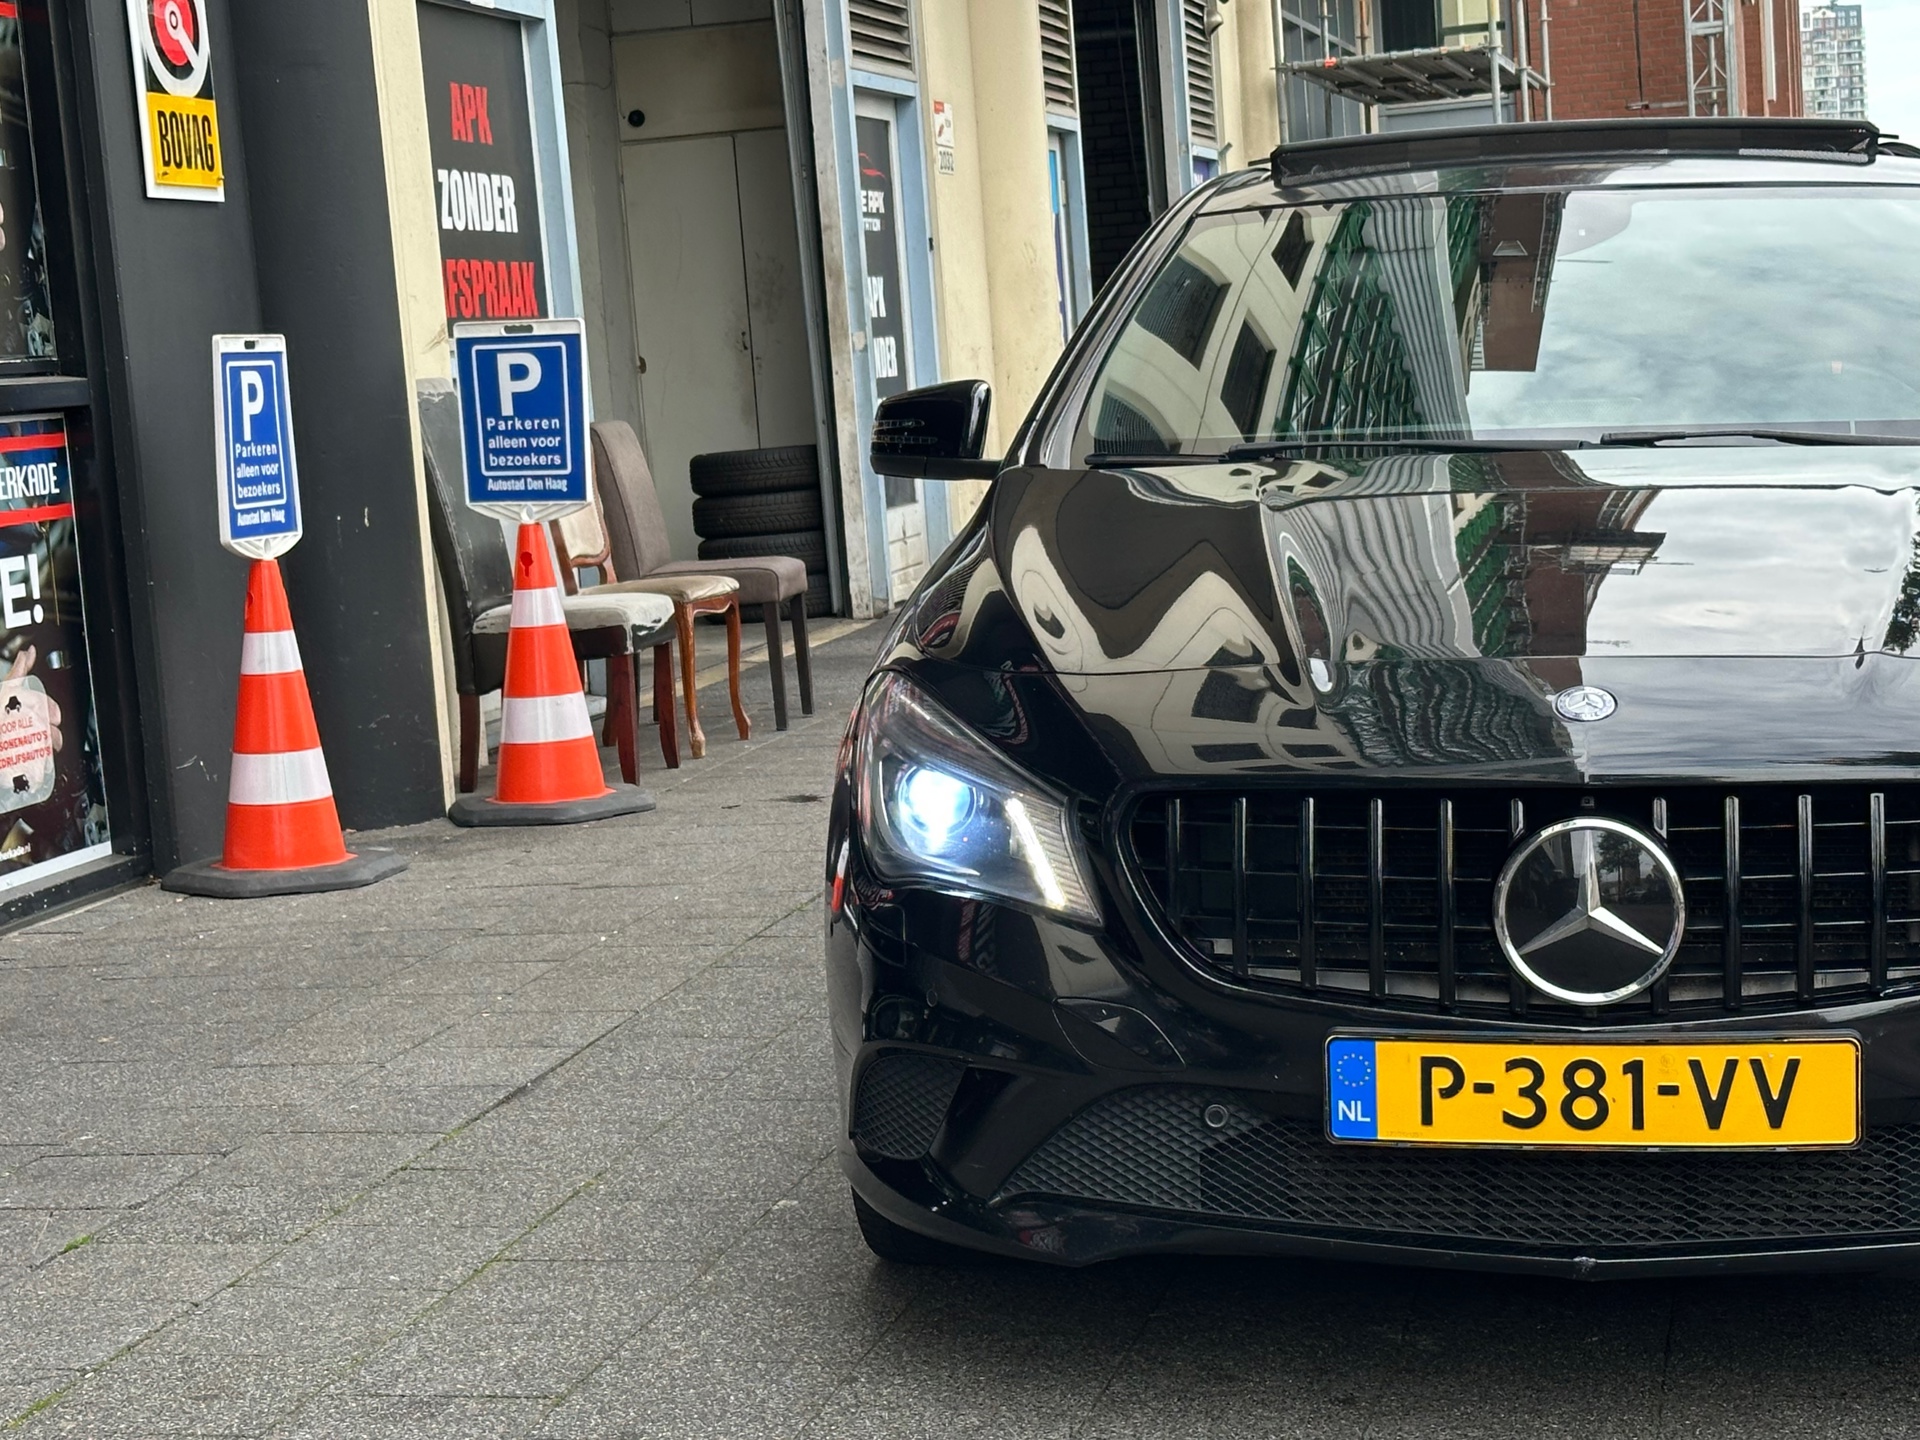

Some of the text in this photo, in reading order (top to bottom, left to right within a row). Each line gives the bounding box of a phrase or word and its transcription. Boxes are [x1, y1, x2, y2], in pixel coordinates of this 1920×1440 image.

[451, 82, 493, 145] APK
[157, 110, 215, 172] BOVAG
[438, 169, 518, 233] ZONDER
[497, 352, 542, 416] P
[240, 370, 264, 441] P
[486, 417, 560, 431] Parkeren
[235, 442, 277, 458] Parkeren
[488, 435, 561, 449] alleen voor
[489, 453, 561, 467] bezoekers
[236, 463, 279, 478] alleen voor
[237, 481, 281, 499] bezoekers
[487, 477, 568, 492] Autostad Den Haag
[1419, 1055, 1801, 1131] P-381-VV
[1337, 1100, 1371, 1122] NL
